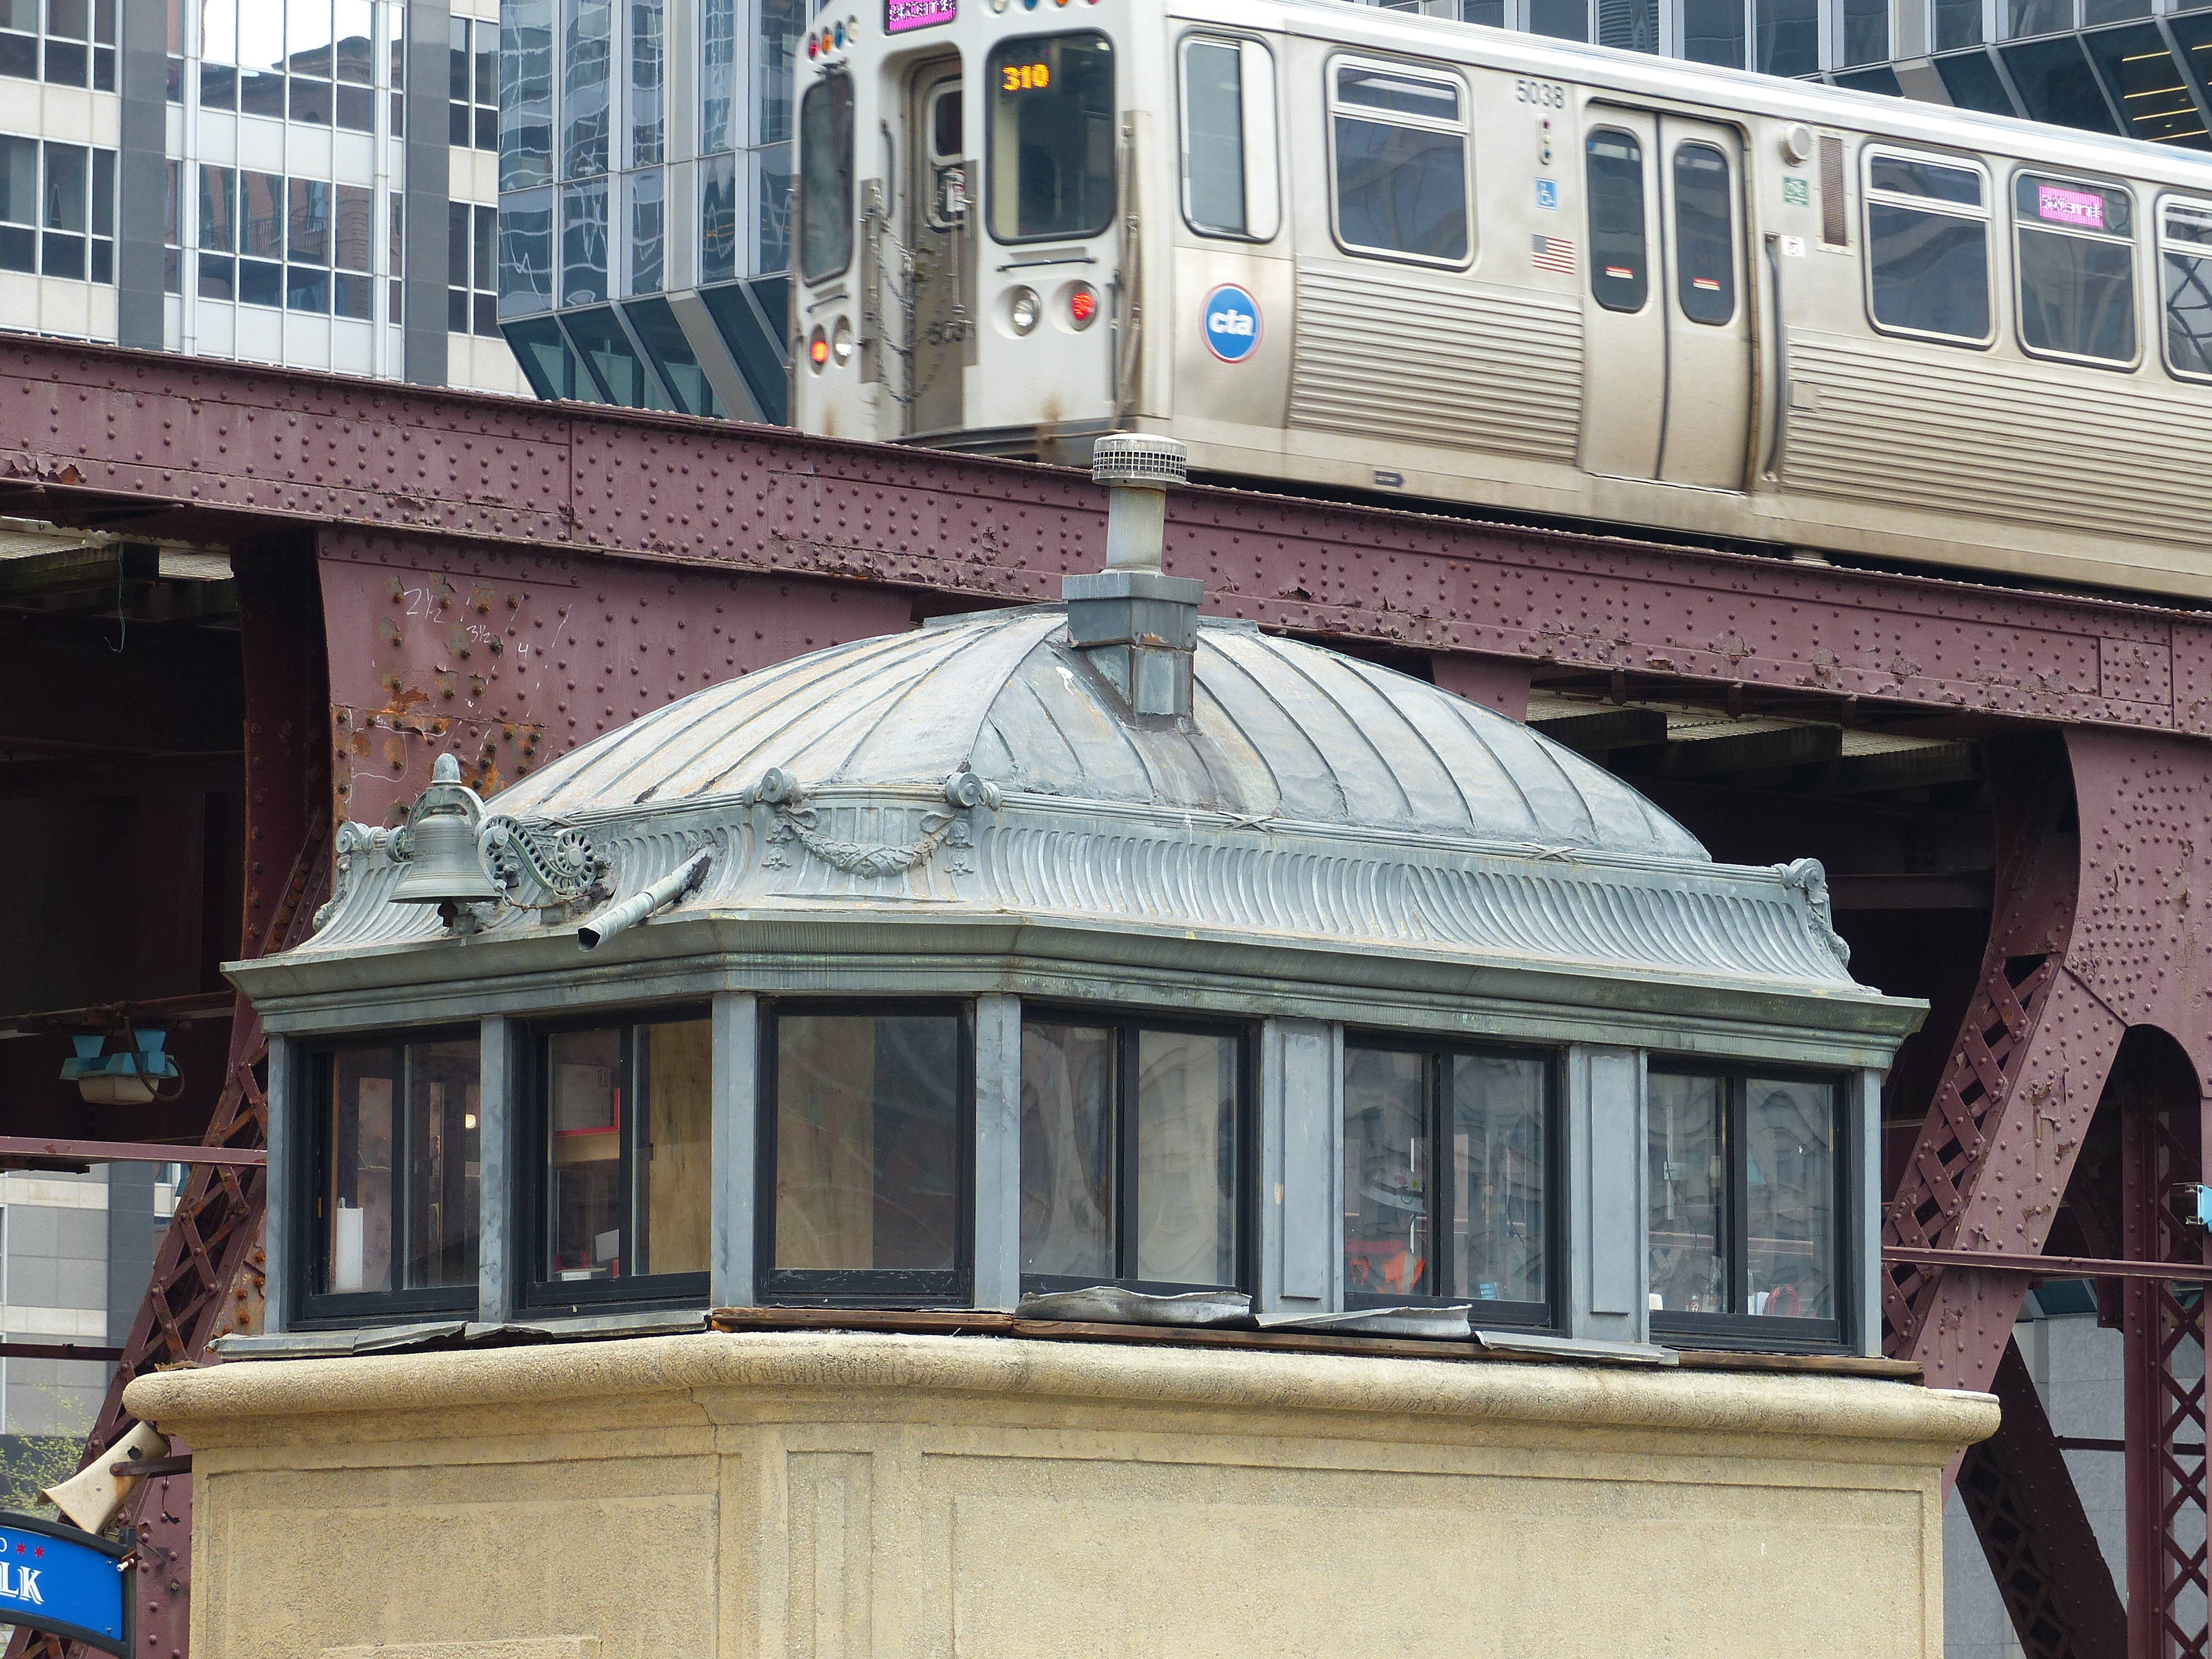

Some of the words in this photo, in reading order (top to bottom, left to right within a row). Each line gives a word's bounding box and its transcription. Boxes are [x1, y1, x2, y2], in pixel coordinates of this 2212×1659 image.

[1002, 64, 1050, 91] 310
[1515, 79, 1565, 109] 5038
[1208, 309, 1254, 336] cta
[518, 642, 529, 658] 4
